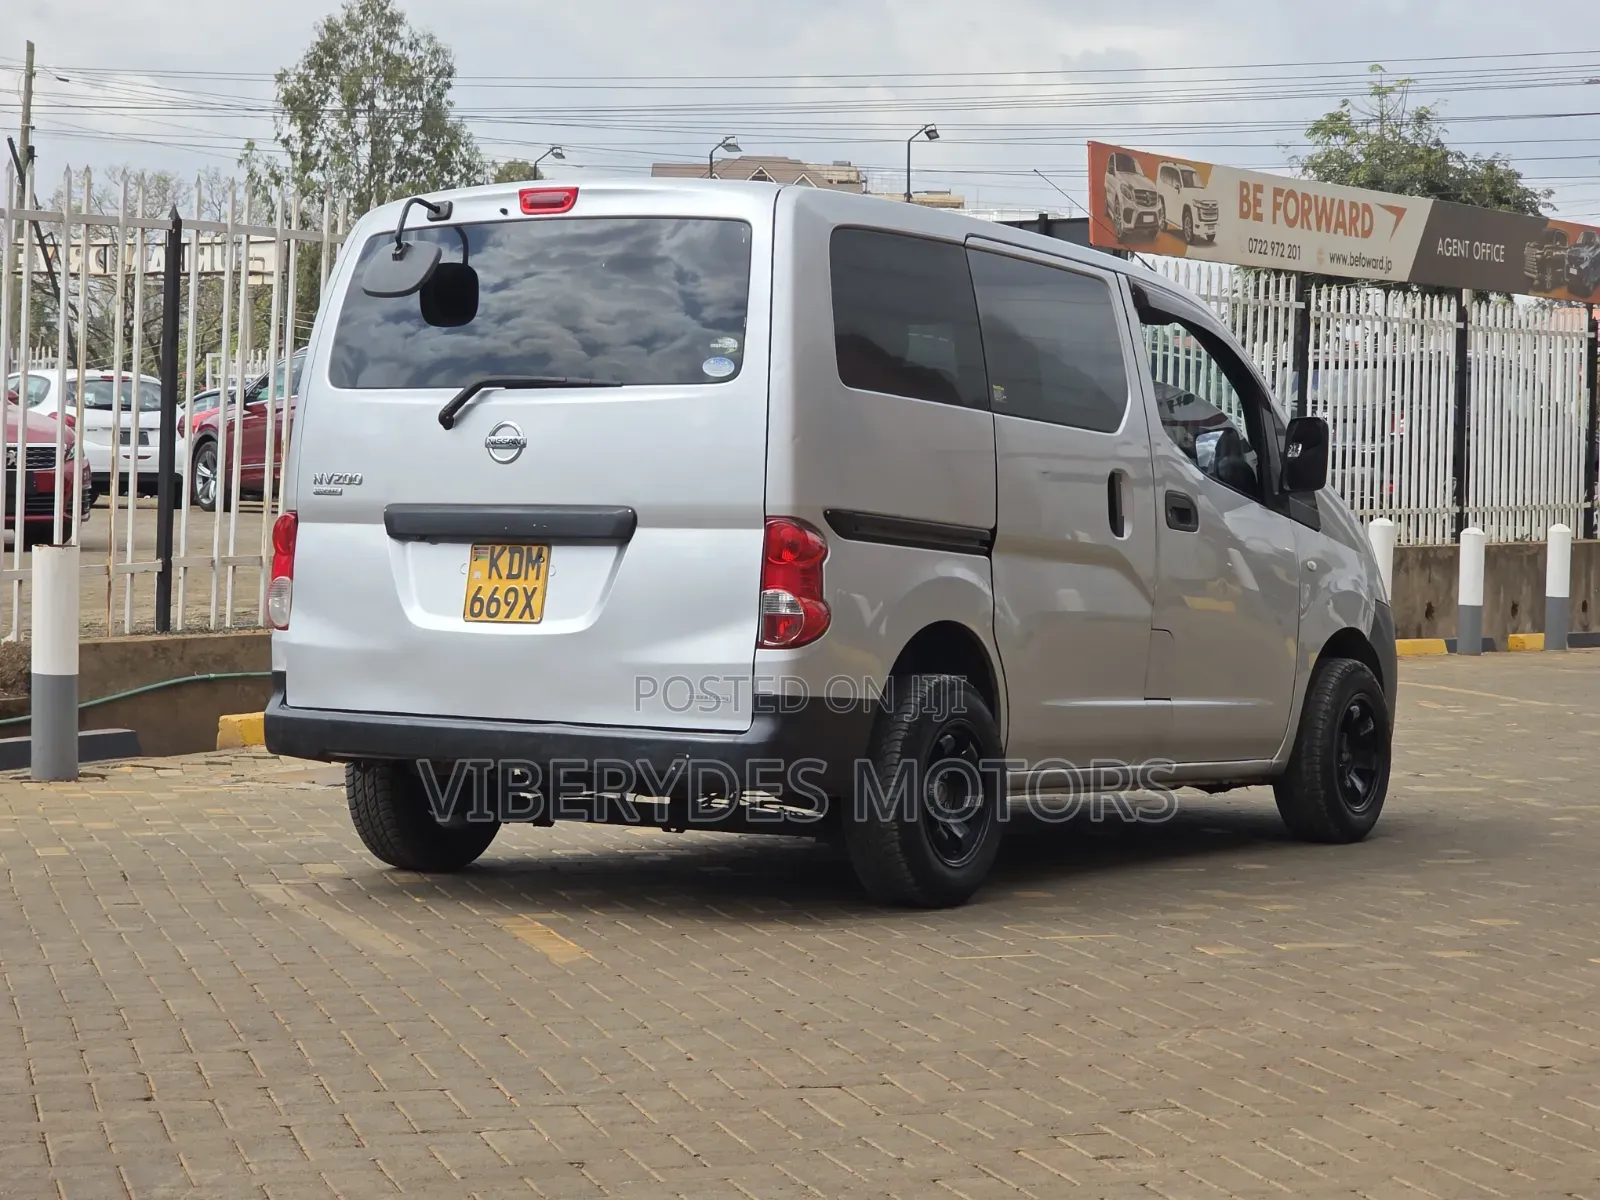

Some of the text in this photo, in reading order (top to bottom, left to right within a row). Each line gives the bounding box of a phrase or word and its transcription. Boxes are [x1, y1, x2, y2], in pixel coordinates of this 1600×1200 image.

[1239, 180, 1374, 239] BE FORWARD
[1248, 237, 1301, 260] 0722 972 201
[1436, 237, 1505, 263] AGENT OFFICE
[1329, 251, 1393, 274] www.befoward.jp
[487, 437, 524, 447] NISSAN
[313, 472, 363, 486] NV200
[487, 545, 544, 580] KDM
[469, 585, 538, 619] 669X
